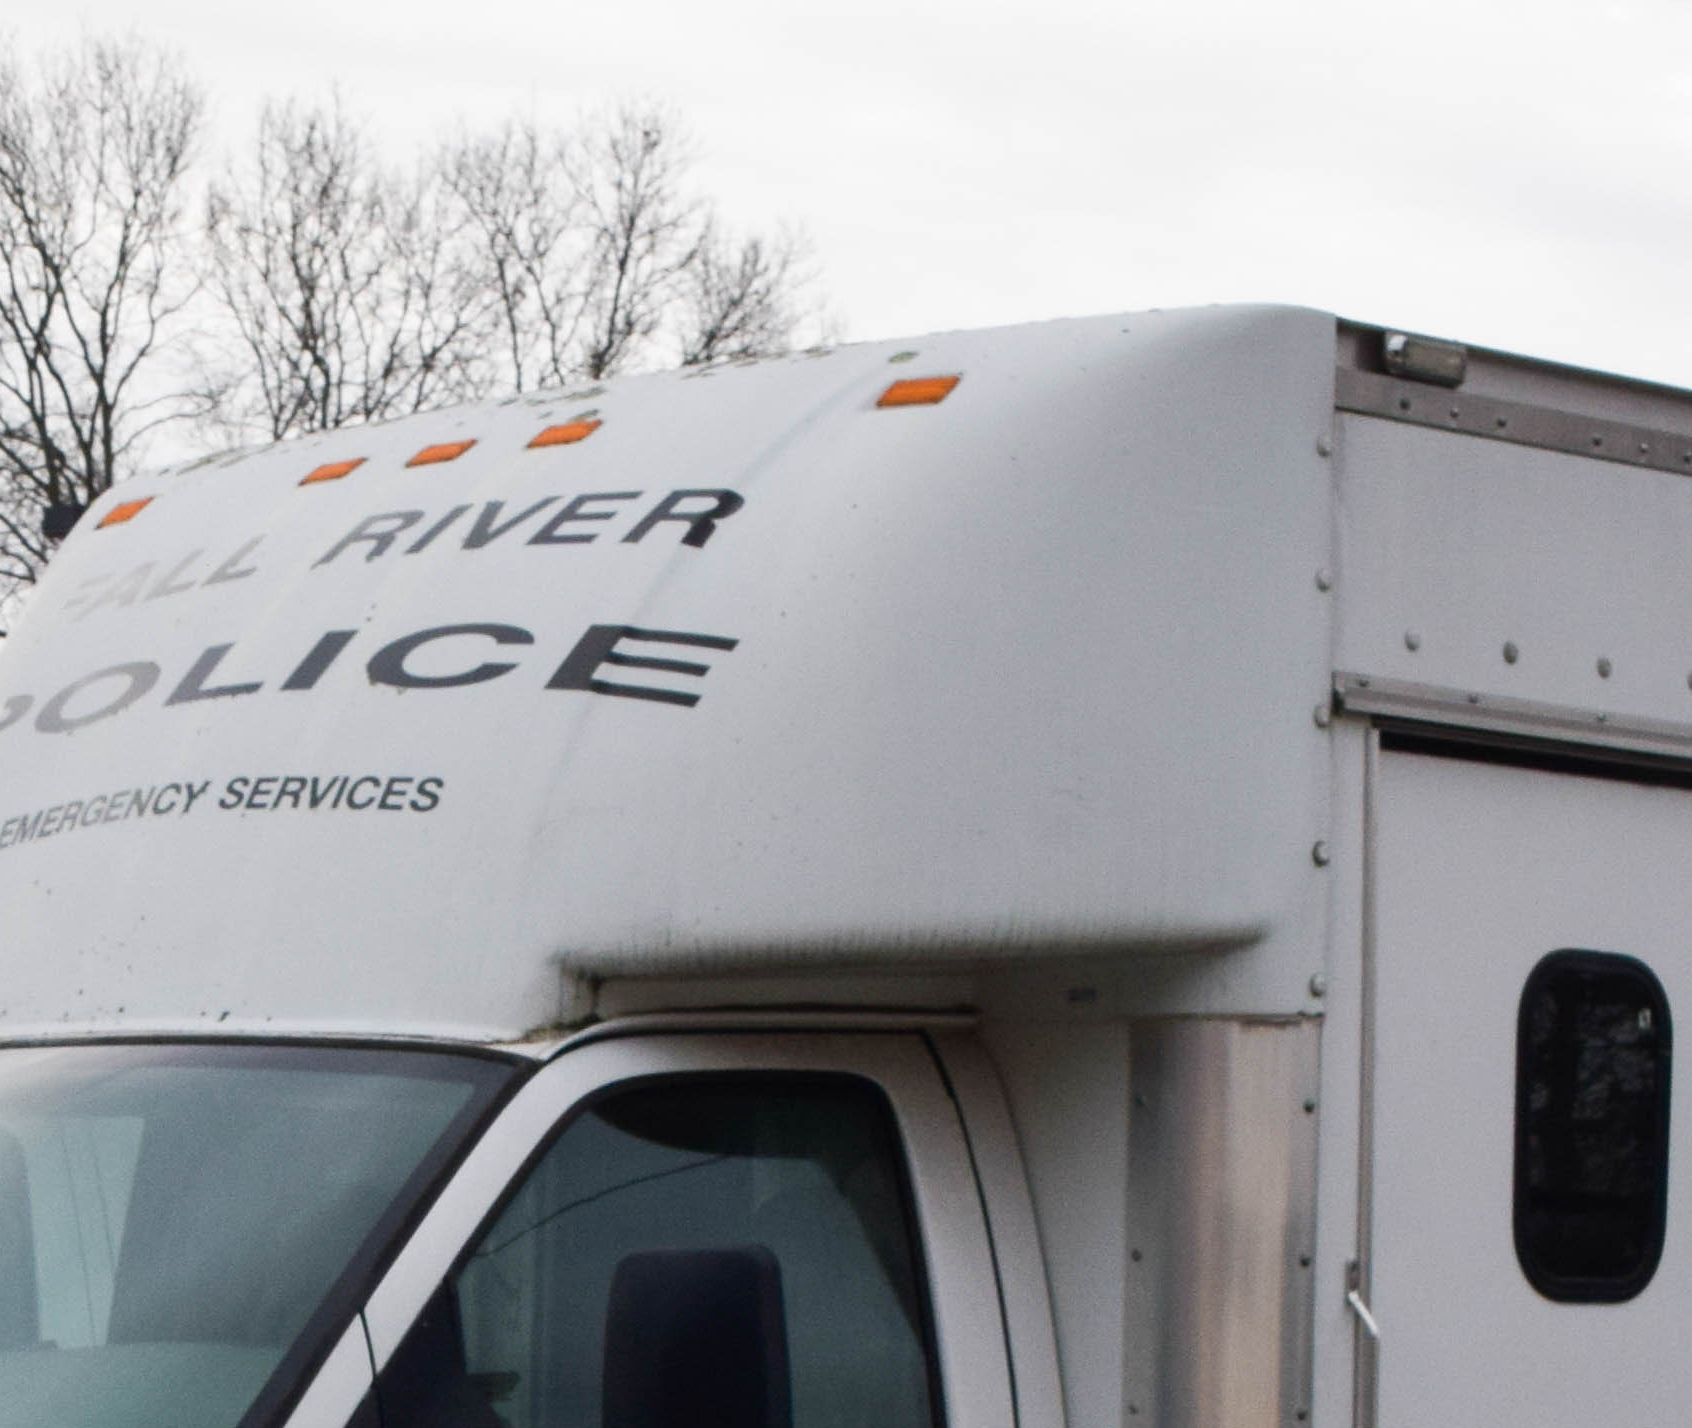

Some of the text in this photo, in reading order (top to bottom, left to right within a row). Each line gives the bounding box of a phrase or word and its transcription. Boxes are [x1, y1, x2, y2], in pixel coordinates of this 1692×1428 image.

[63, 488, 746, 624] FALL RIVER
[219, 776, 445, 813] SERVICES
